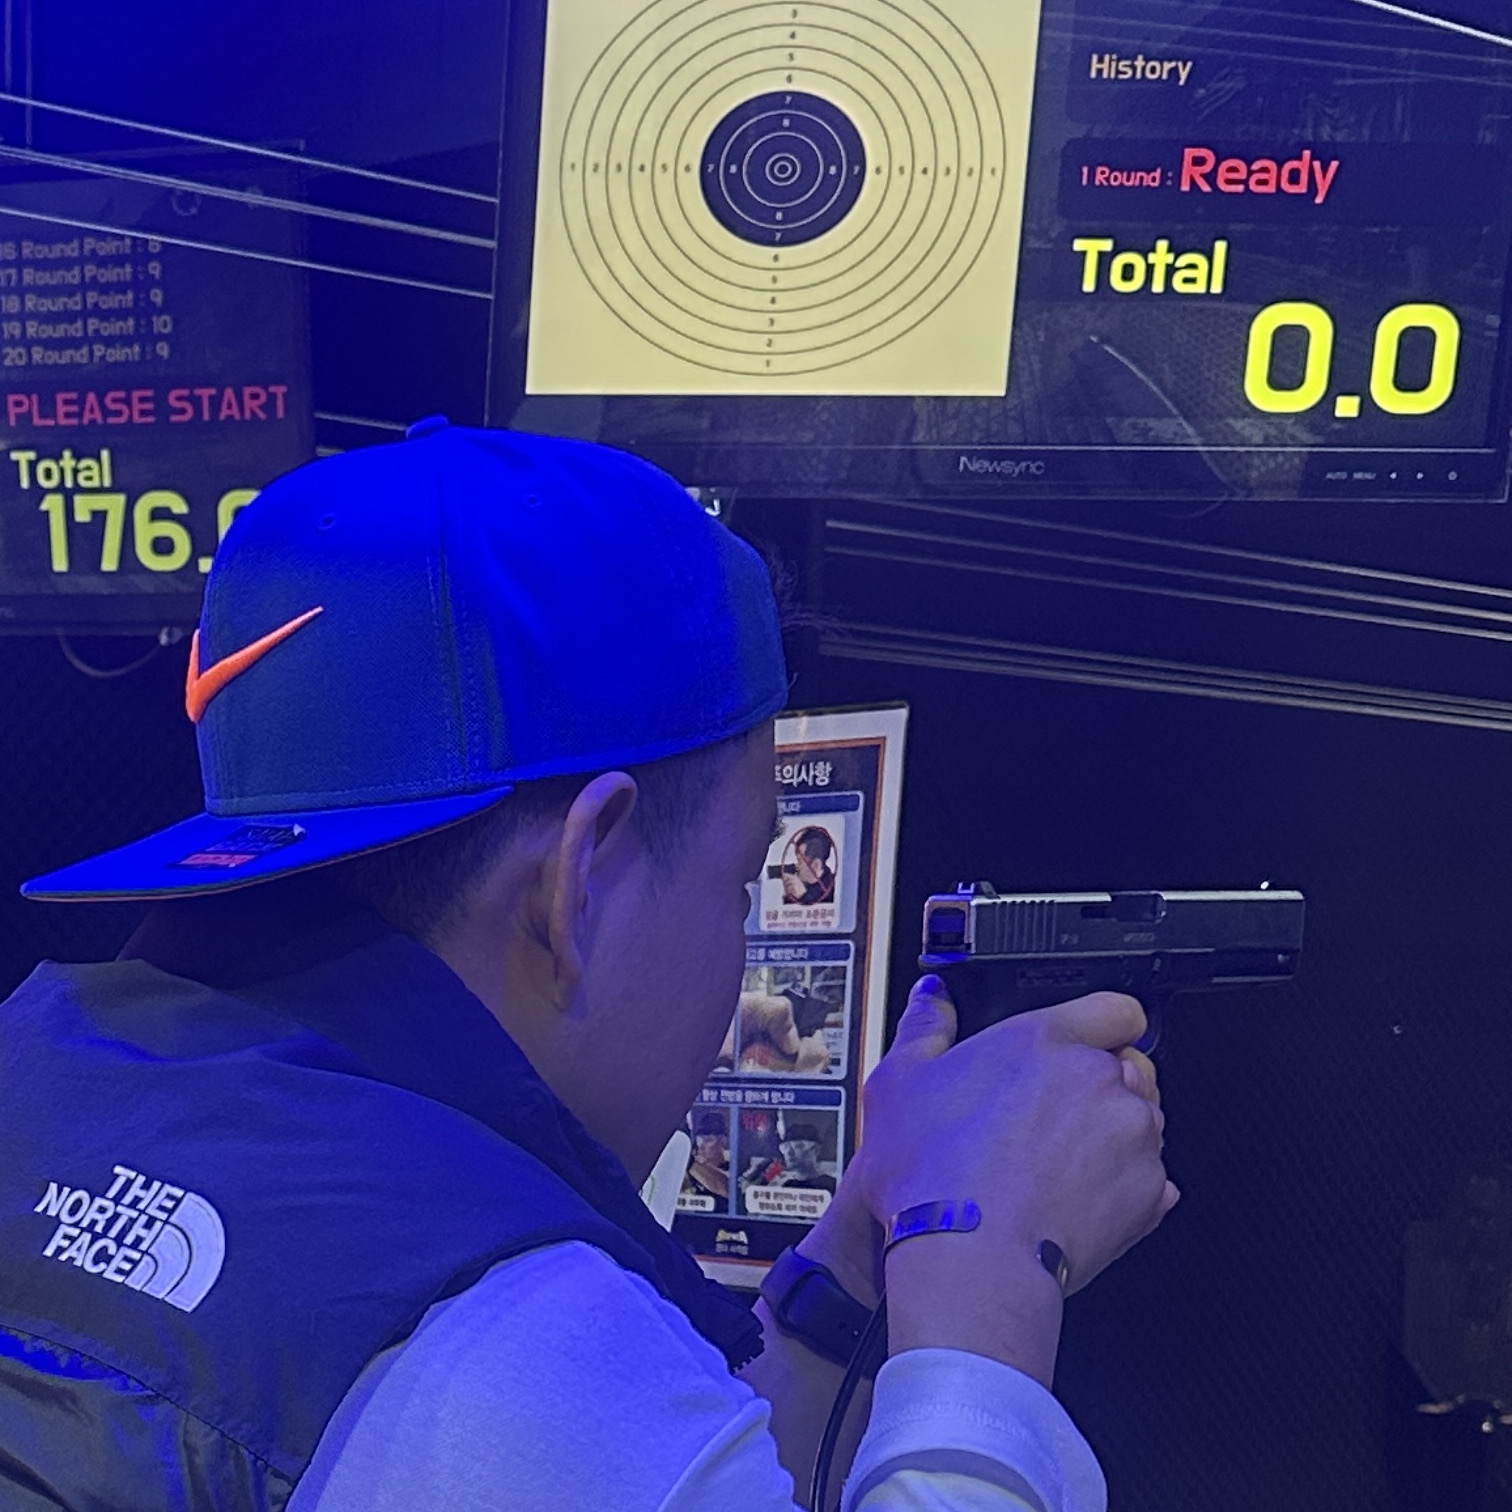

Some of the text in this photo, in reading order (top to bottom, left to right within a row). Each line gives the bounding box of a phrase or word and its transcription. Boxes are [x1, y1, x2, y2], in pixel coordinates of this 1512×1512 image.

[1090, 54, 1192, 86] History
[1081, 167, 1089, 187] 1
[1094, 167, 1161, 188] Round
[1180, 148, 1340, 204] Ready
[1072, 239, 1228, 294] Total
[152, 315, 173, 334] 10
[1243, 301, 1461, 418] 0.0
[6, 385, 288, 427] PLEASE START
[9, 448, 113, 490] Total
[958, 455, 1045, 476] Newsync
[34, 1182, 165, 1251] NORTH
[104, 1165, 186, 1221] THE
[42, 1223, 143, 1283] FACE
